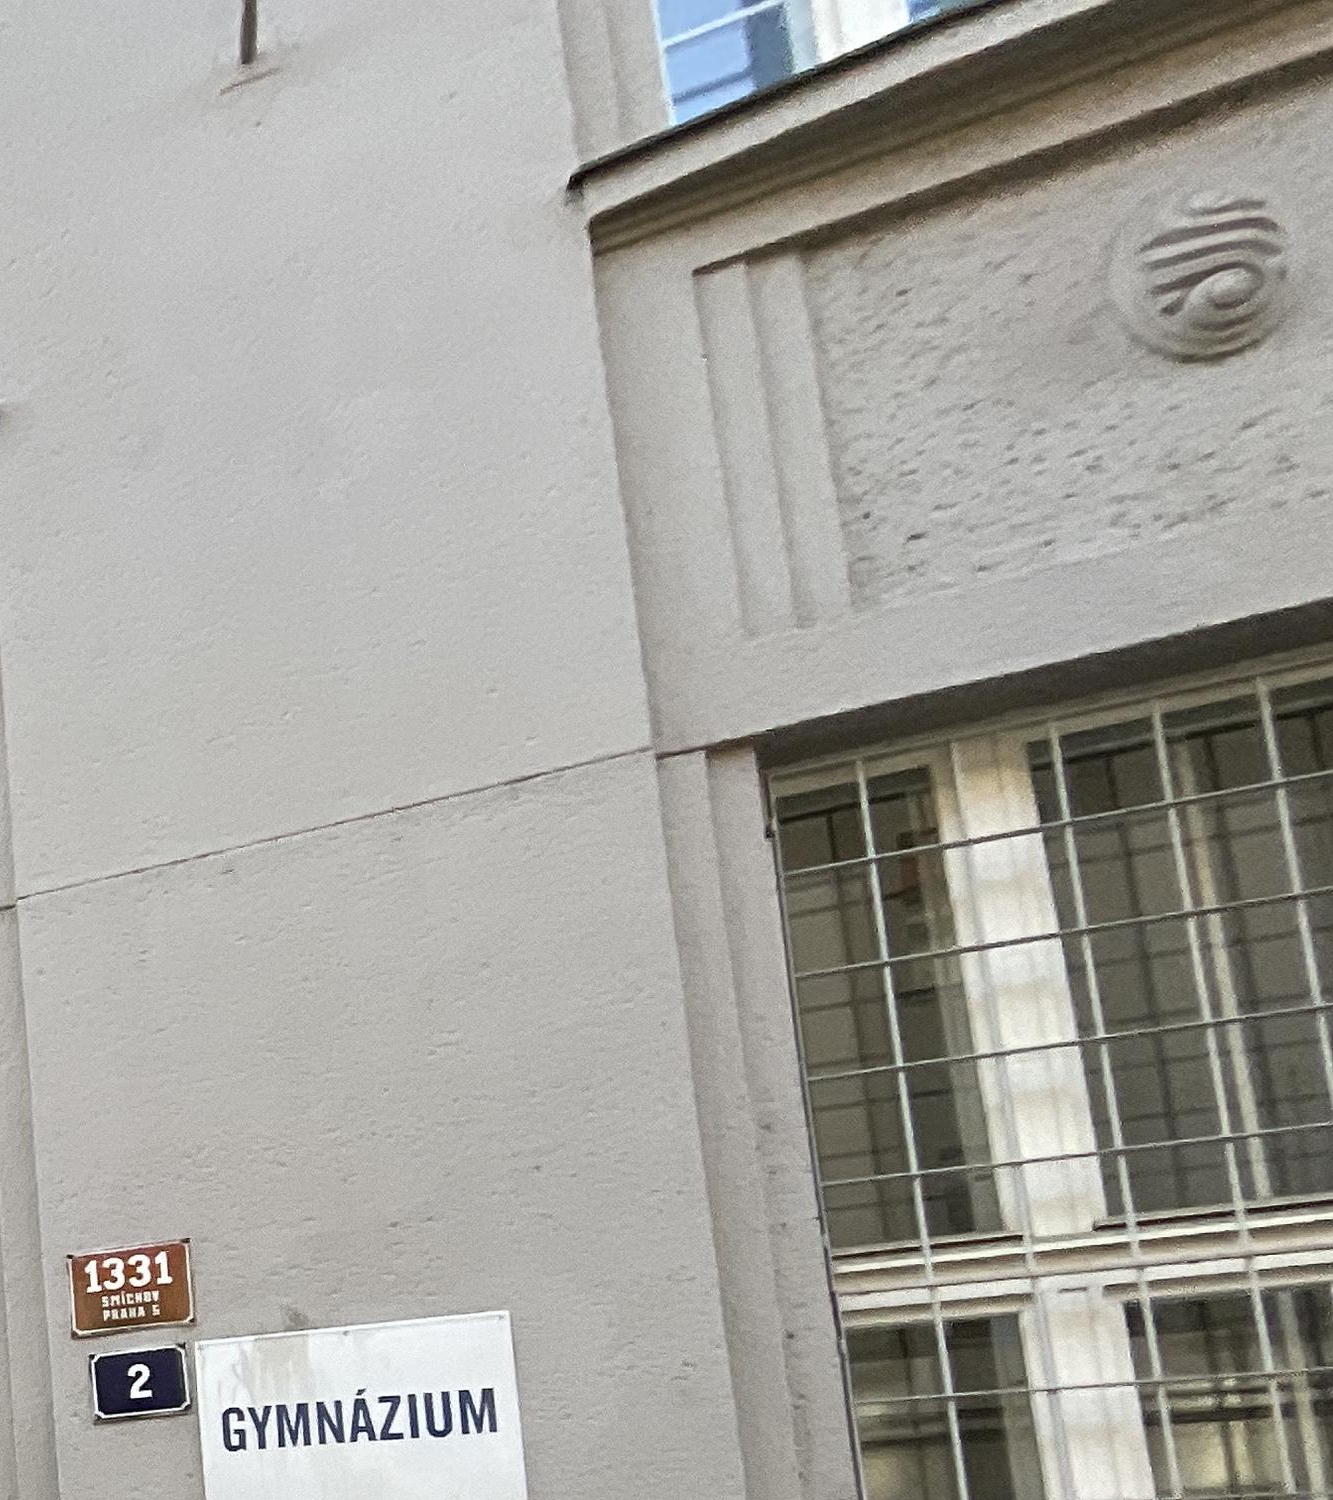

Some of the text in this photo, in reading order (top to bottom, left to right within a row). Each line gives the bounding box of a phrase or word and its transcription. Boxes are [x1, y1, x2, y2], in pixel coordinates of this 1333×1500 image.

[84, 1251, 173, 1294] 1331
[101, 1290, 160, 1308] SMÍCHOV
[103, 1304, 161, 1322] PRAHA 5
[127, 1363, 153, 1399] 2
[222, 1388, 498, 1452] GYMNÁZIUM
